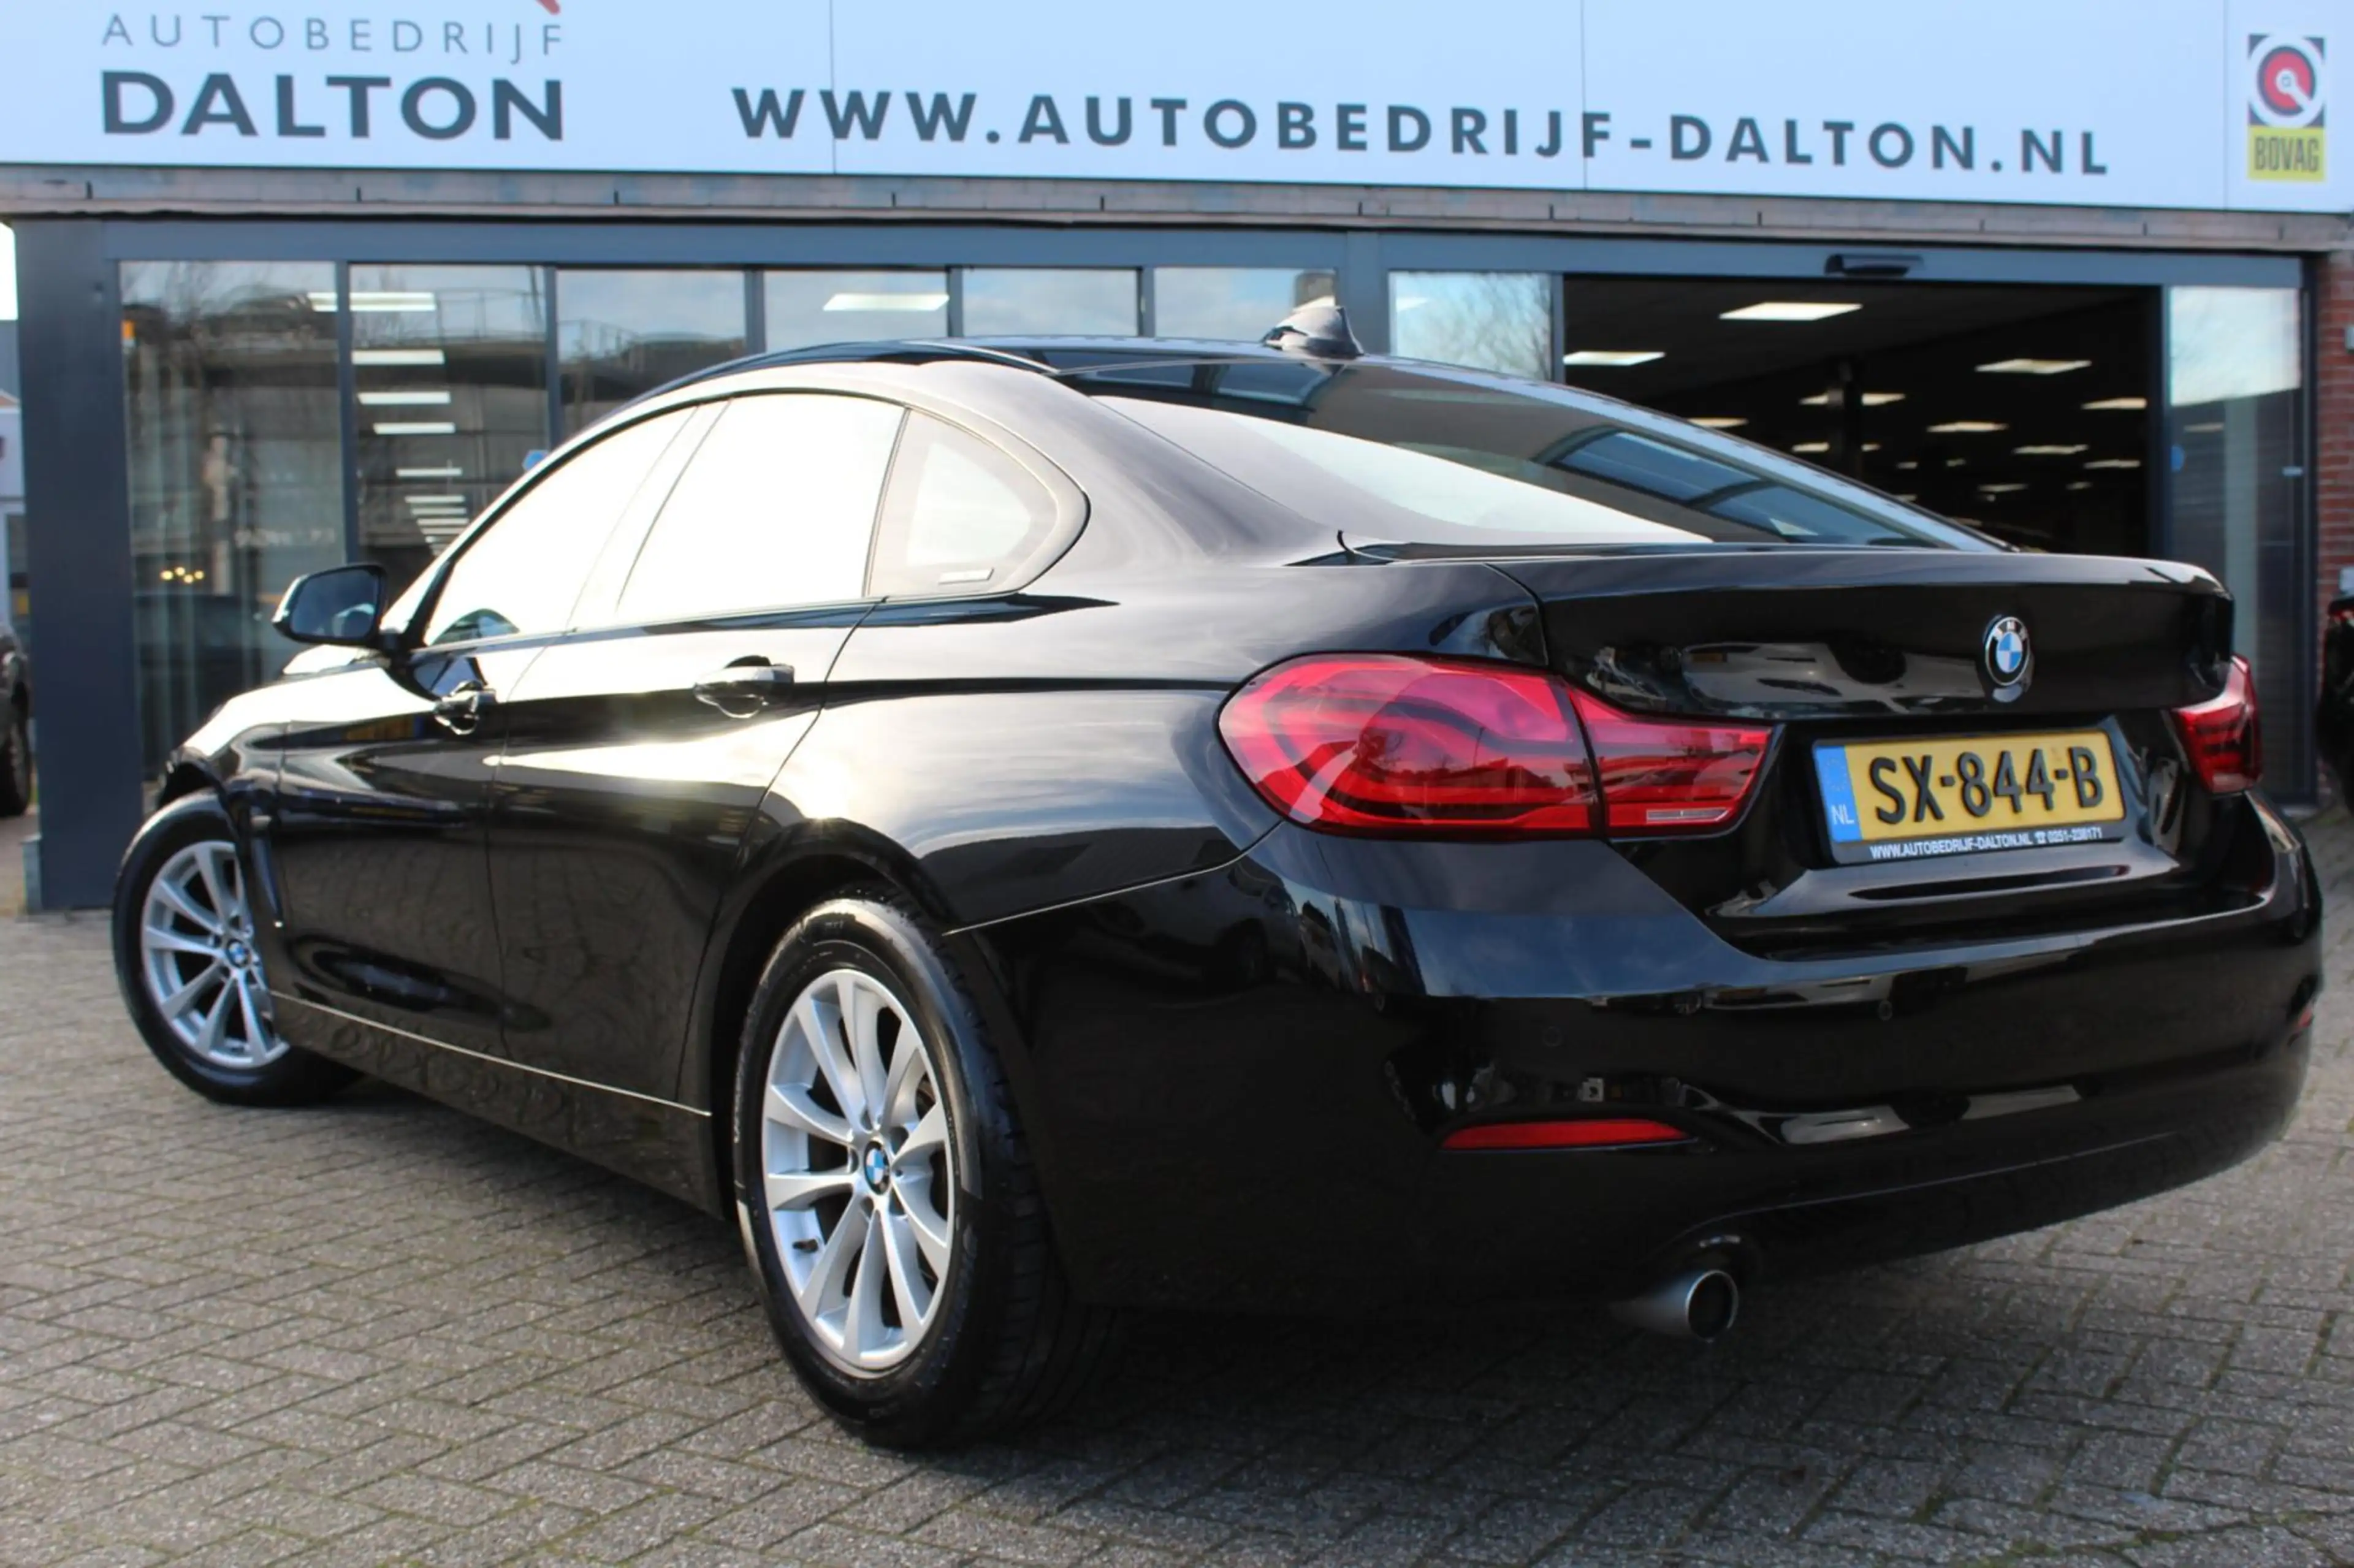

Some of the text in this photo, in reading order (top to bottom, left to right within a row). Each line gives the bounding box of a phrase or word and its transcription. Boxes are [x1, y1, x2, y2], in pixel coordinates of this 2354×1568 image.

[102, 13, 562, 65] AUTOBEDRIJF
[101, 70, 563, 141] DALTON
[731, 87, 2108, 175] WWW.AUTOBEDRIJF-DALTON.NL
[2254, 136, 2320, 172] BOVAG
[1868, 745, 2104, 824] SX-844-B
[1830, 804, 1855, 826] NL
[1870, 832, 2033, 859] WWW.AUTOBEDRIJF-DALTON.NL
